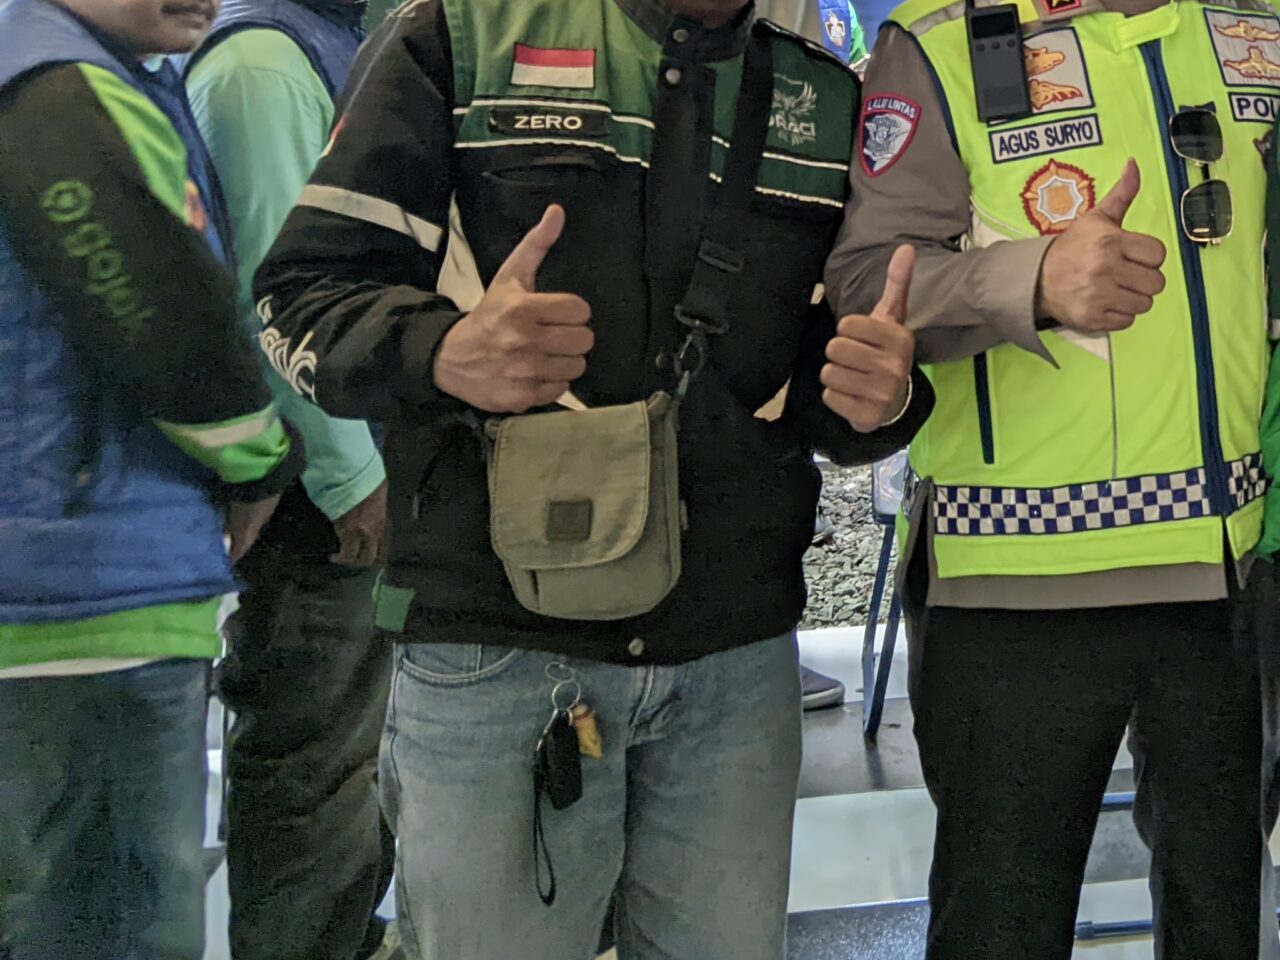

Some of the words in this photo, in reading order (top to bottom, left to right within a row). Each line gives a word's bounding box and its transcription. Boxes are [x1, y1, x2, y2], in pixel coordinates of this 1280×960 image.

[888, 99, 916, 118] LINTAS
[514, 114, 582, 130] ZERO
[999, 130, 1040, 156] AGUS
[1044, 121, 1093, 147] SURYO
